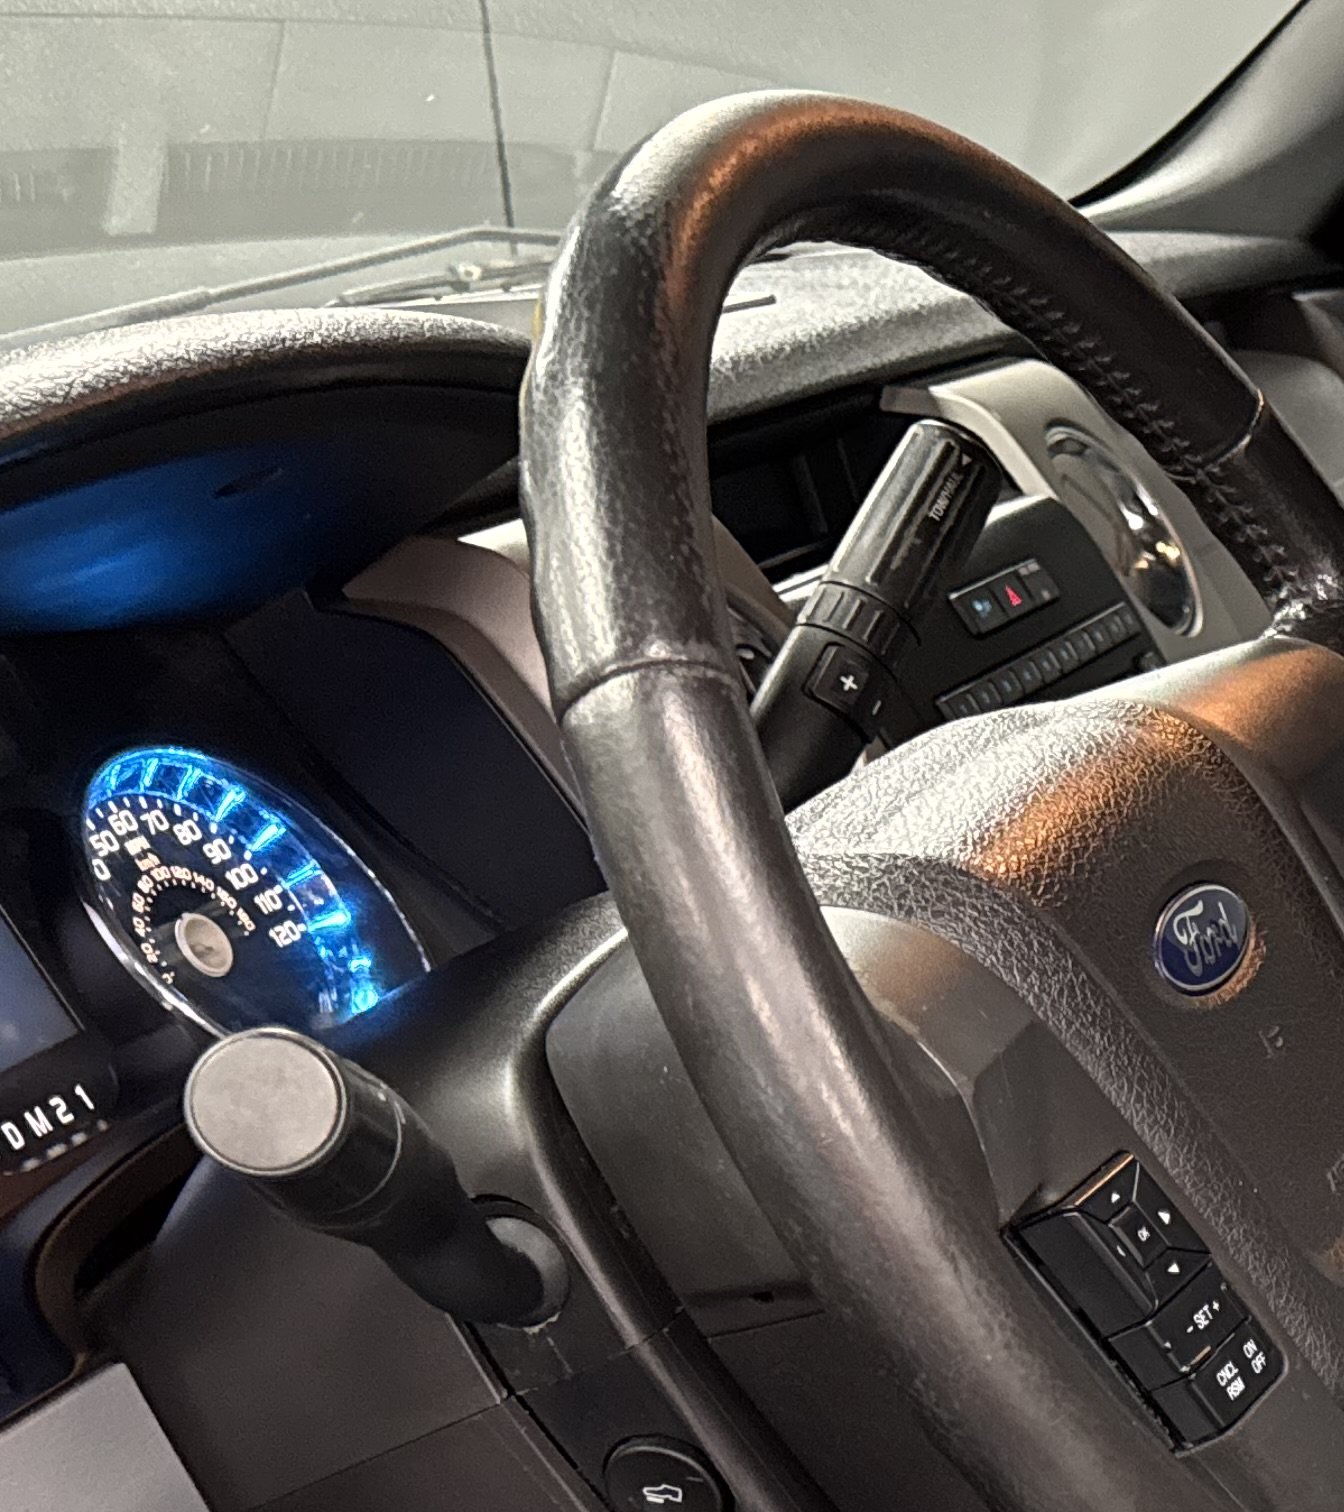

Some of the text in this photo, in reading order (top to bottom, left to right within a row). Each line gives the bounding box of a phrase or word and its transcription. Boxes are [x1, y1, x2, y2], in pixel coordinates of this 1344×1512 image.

[89, 830, 120, 857] 50
[108, 810, 138, 836] 60
[140, 809, 169, 835] 70
[173, 819, 202, 845] 80
[202, 838, 232, 864] 90
[225, 863, 259, 890] 100
[253, 889, 283, 915] 110
[268, 920, 301, 948] 120
[1173, 899, 1241, 977] Ford
[1193, 1304, 1213, 1330] SET
[1243, 1338, 1258, 1359] ON
[1251, 1352, 1267, 1374] OFF
